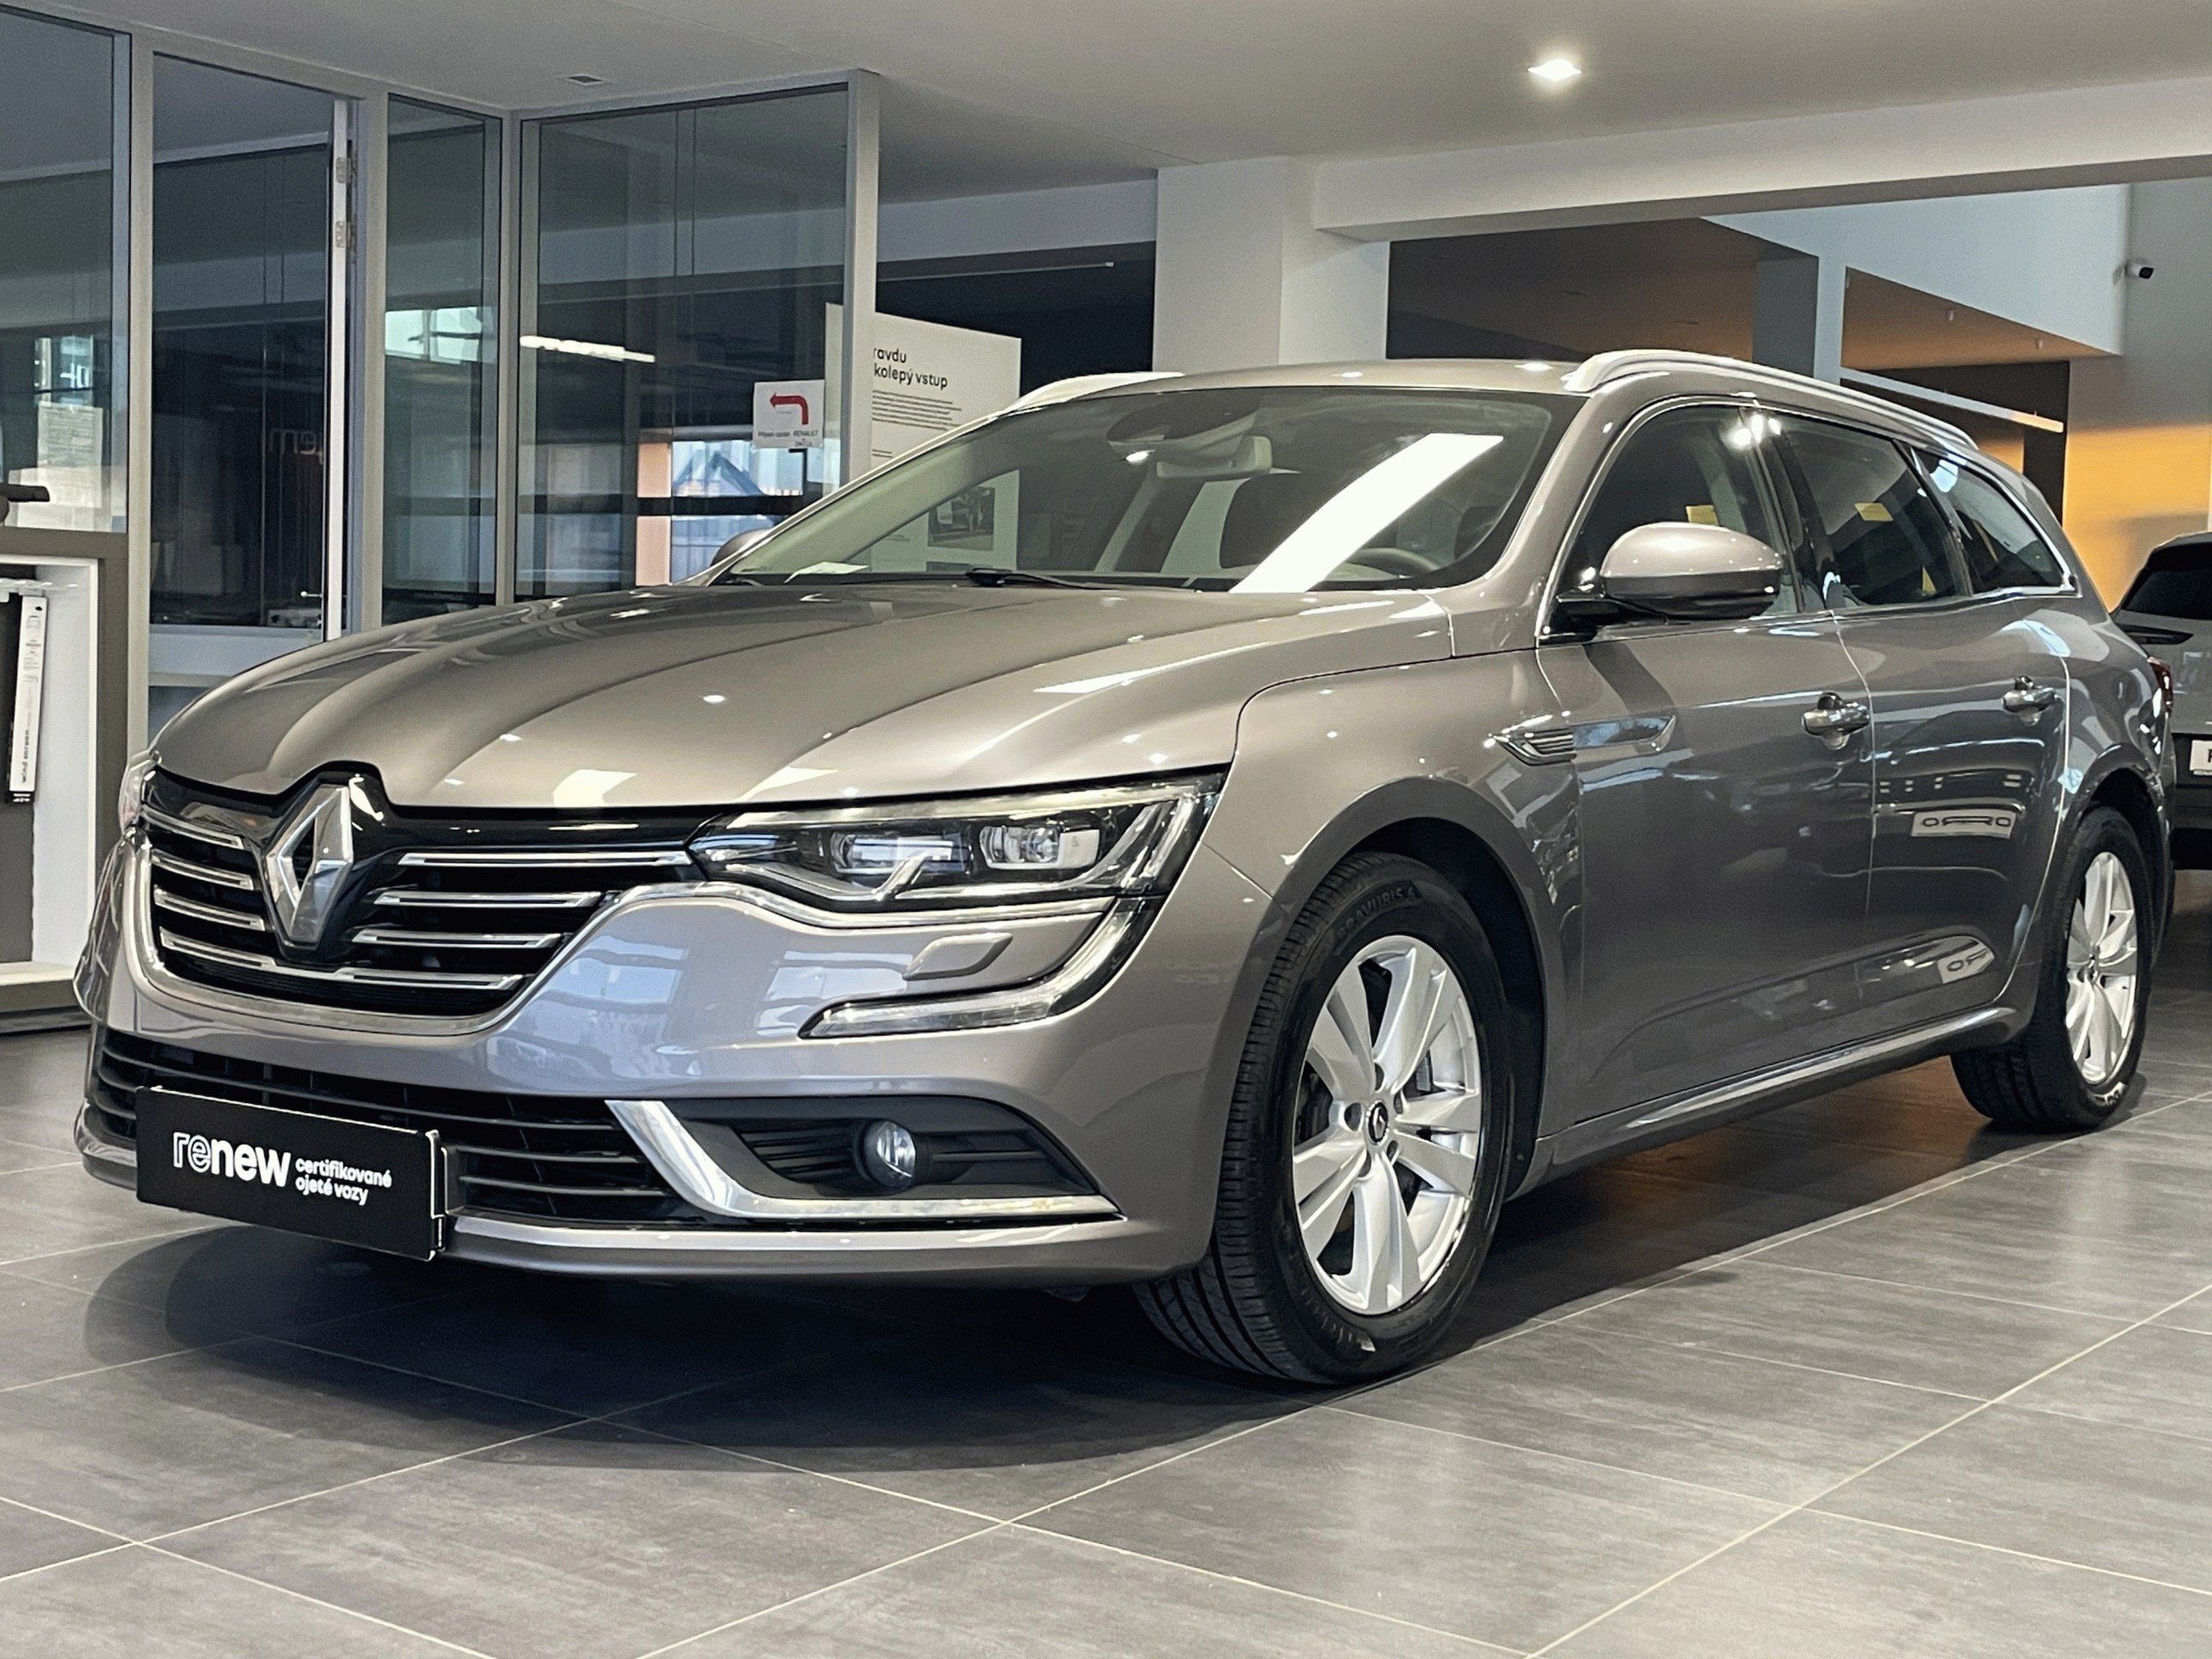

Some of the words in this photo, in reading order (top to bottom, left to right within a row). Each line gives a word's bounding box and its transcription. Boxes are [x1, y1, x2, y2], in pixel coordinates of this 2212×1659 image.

[915, 372, 948, 390] vstup
[173, 1131, 291, 1188] renew
[295, 1158, 392, 1189] certifikované
[295, 1174, 333, 1196] ojeté
[334, 1183, 368, 1206] vozy
